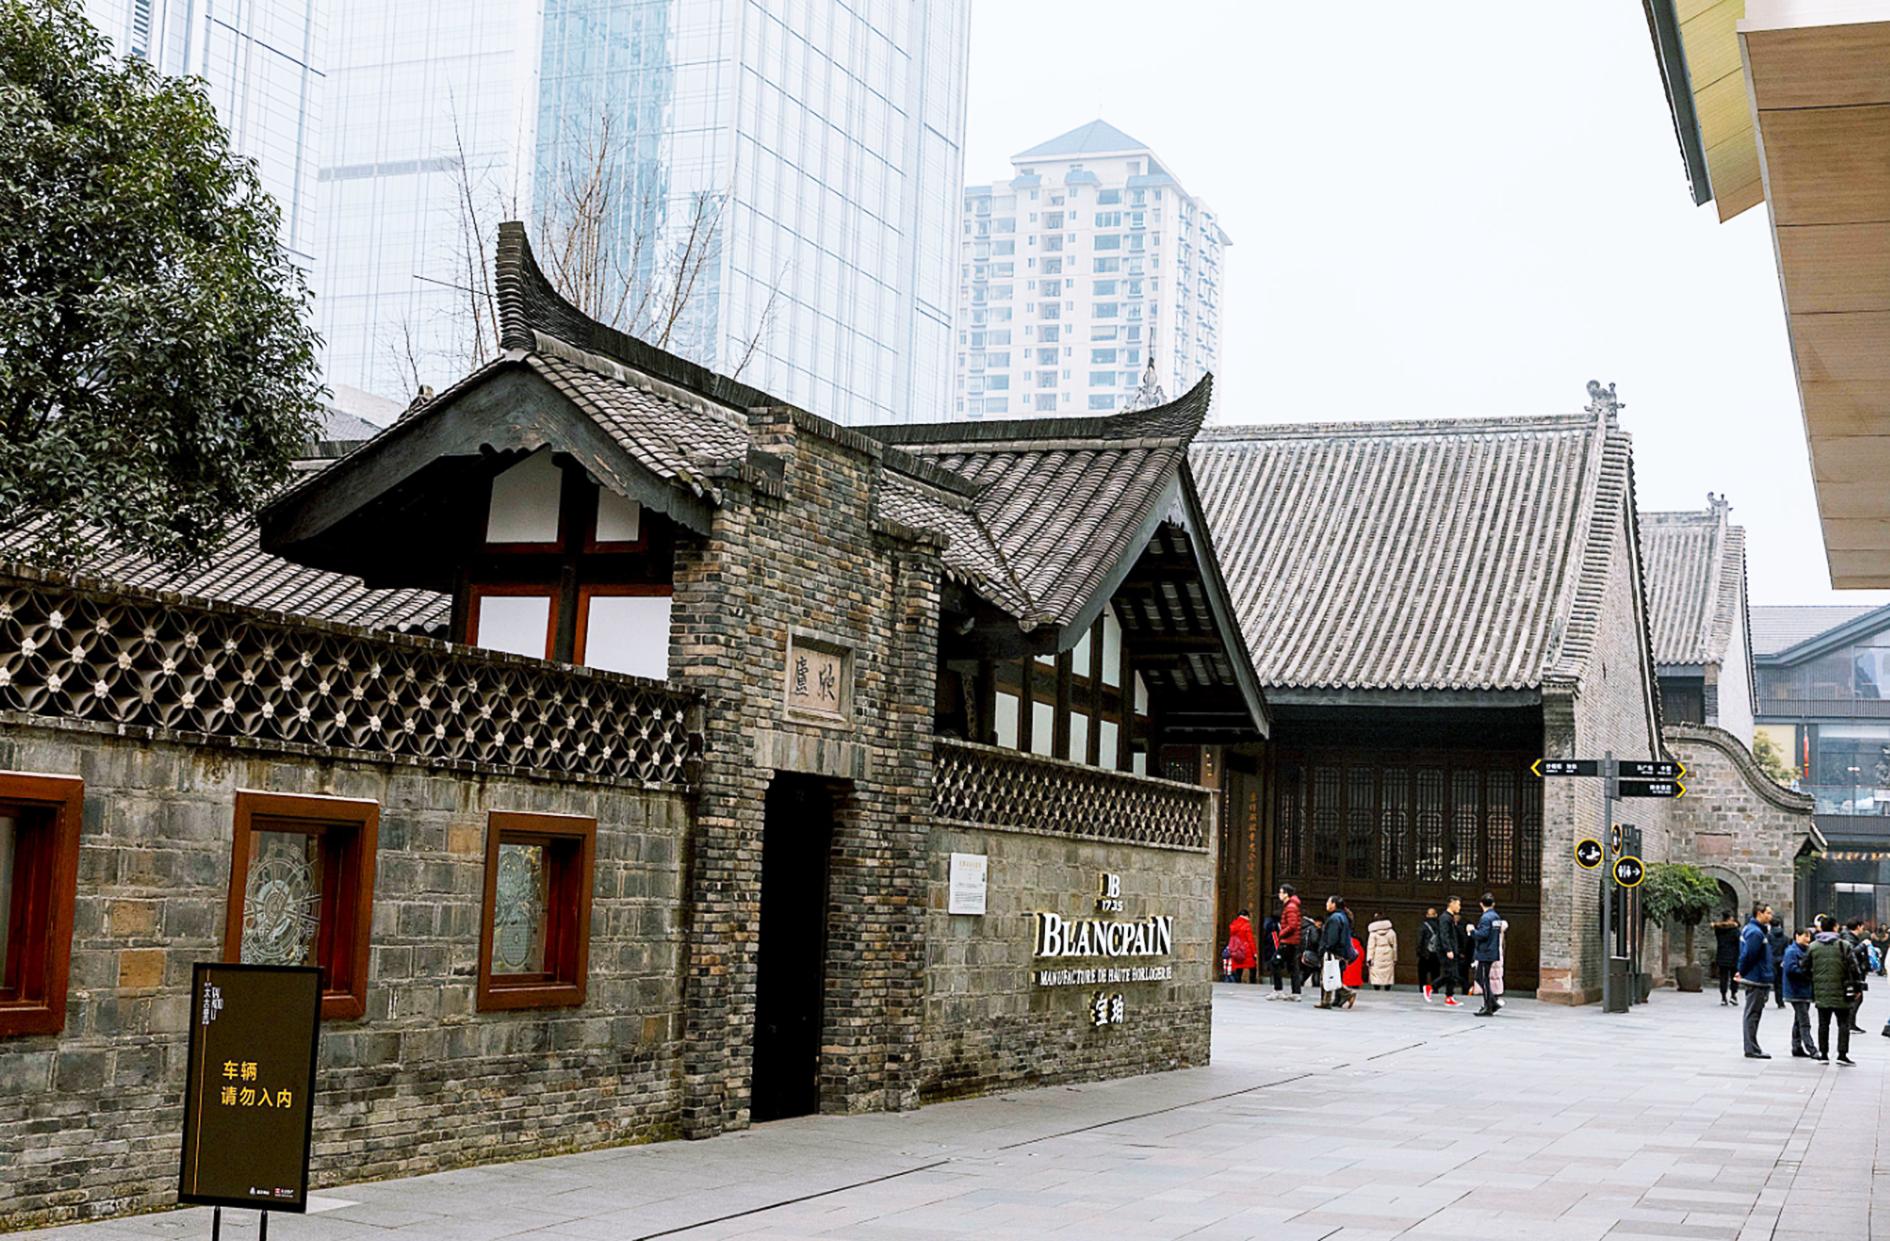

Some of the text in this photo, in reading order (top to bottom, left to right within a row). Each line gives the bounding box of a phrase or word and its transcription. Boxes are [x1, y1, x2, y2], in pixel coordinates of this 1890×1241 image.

[1101, 899, 1123, 912] 1735
[1038, 912, 1173, 957] BLANCPAIN
[1040, 966, 1173, 986] MANUFACTURE DE HAUTE HORLOGERIE
[222, 1060, 258, 1081] 车辆
[221, 1085, 293, 1109] 请勿入内
